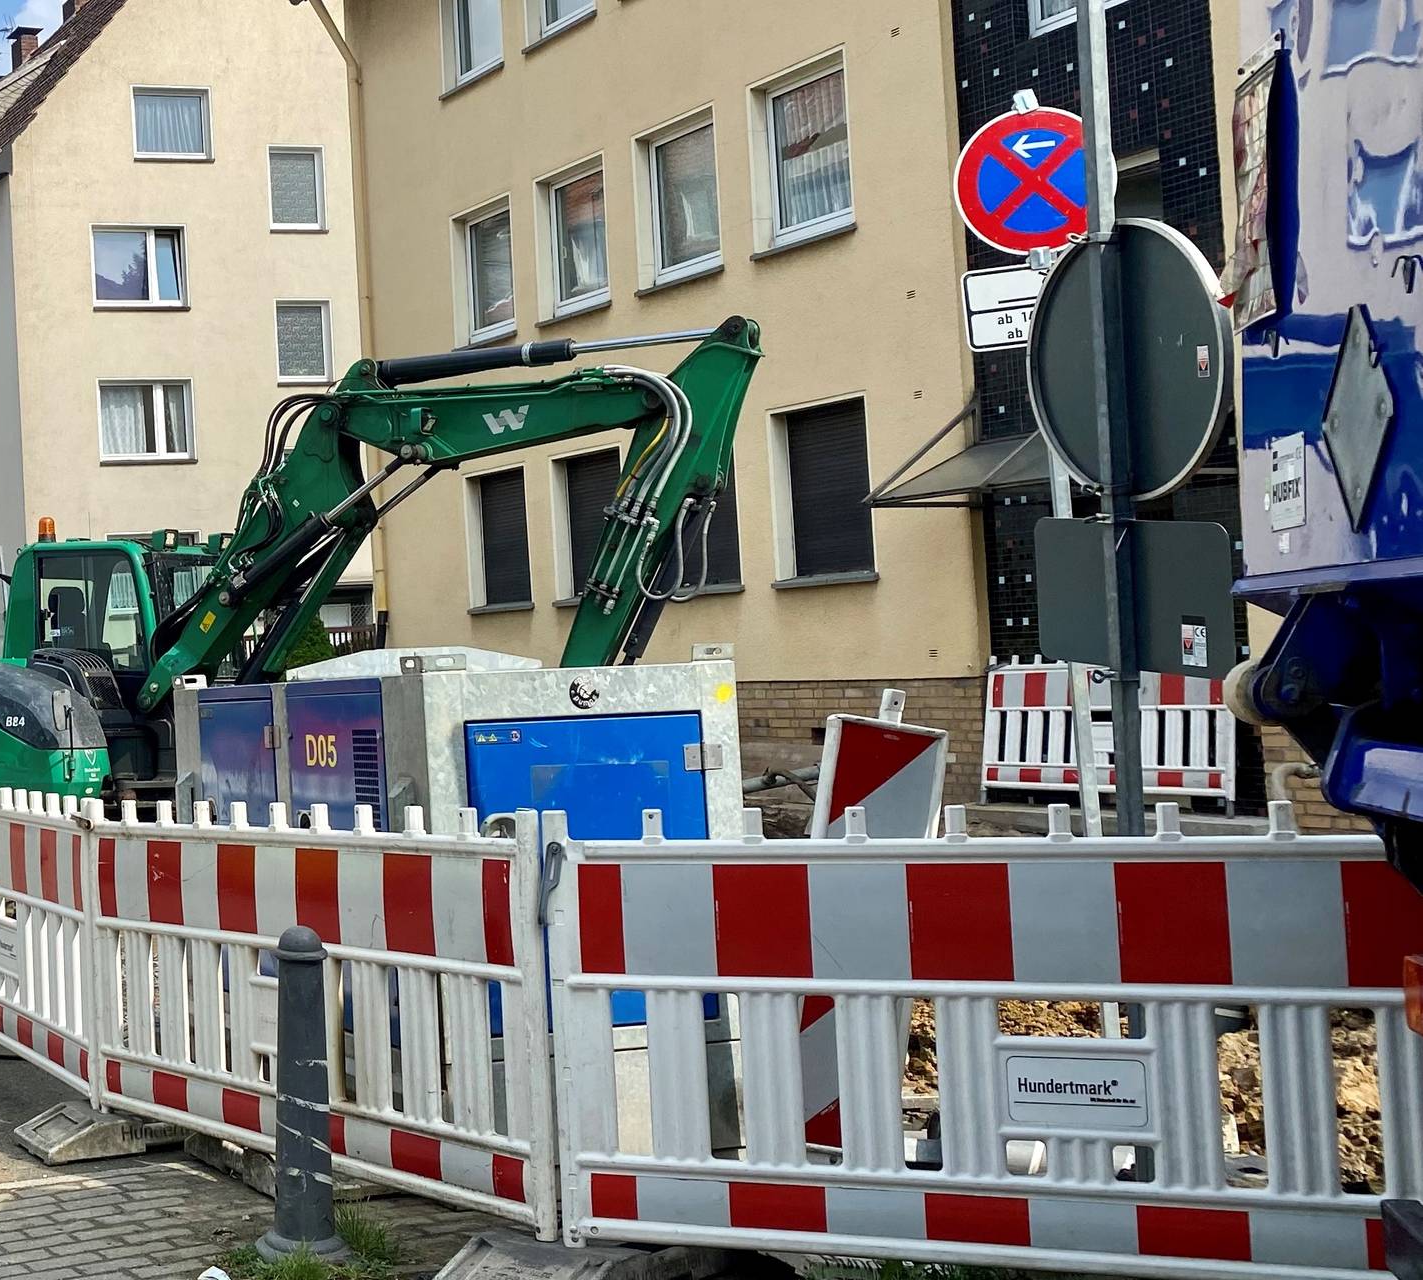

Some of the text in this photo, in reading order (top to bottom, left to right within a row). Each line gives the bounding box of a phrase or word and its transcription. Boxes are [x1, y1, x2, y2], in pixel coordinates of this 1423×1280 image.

[997, 313, 1013, 325] ab
[1007, 327, 1023, 339] ab
[1272, 476, 1302, 504] HUBFIX
[305, 734, 338, 768] D05
